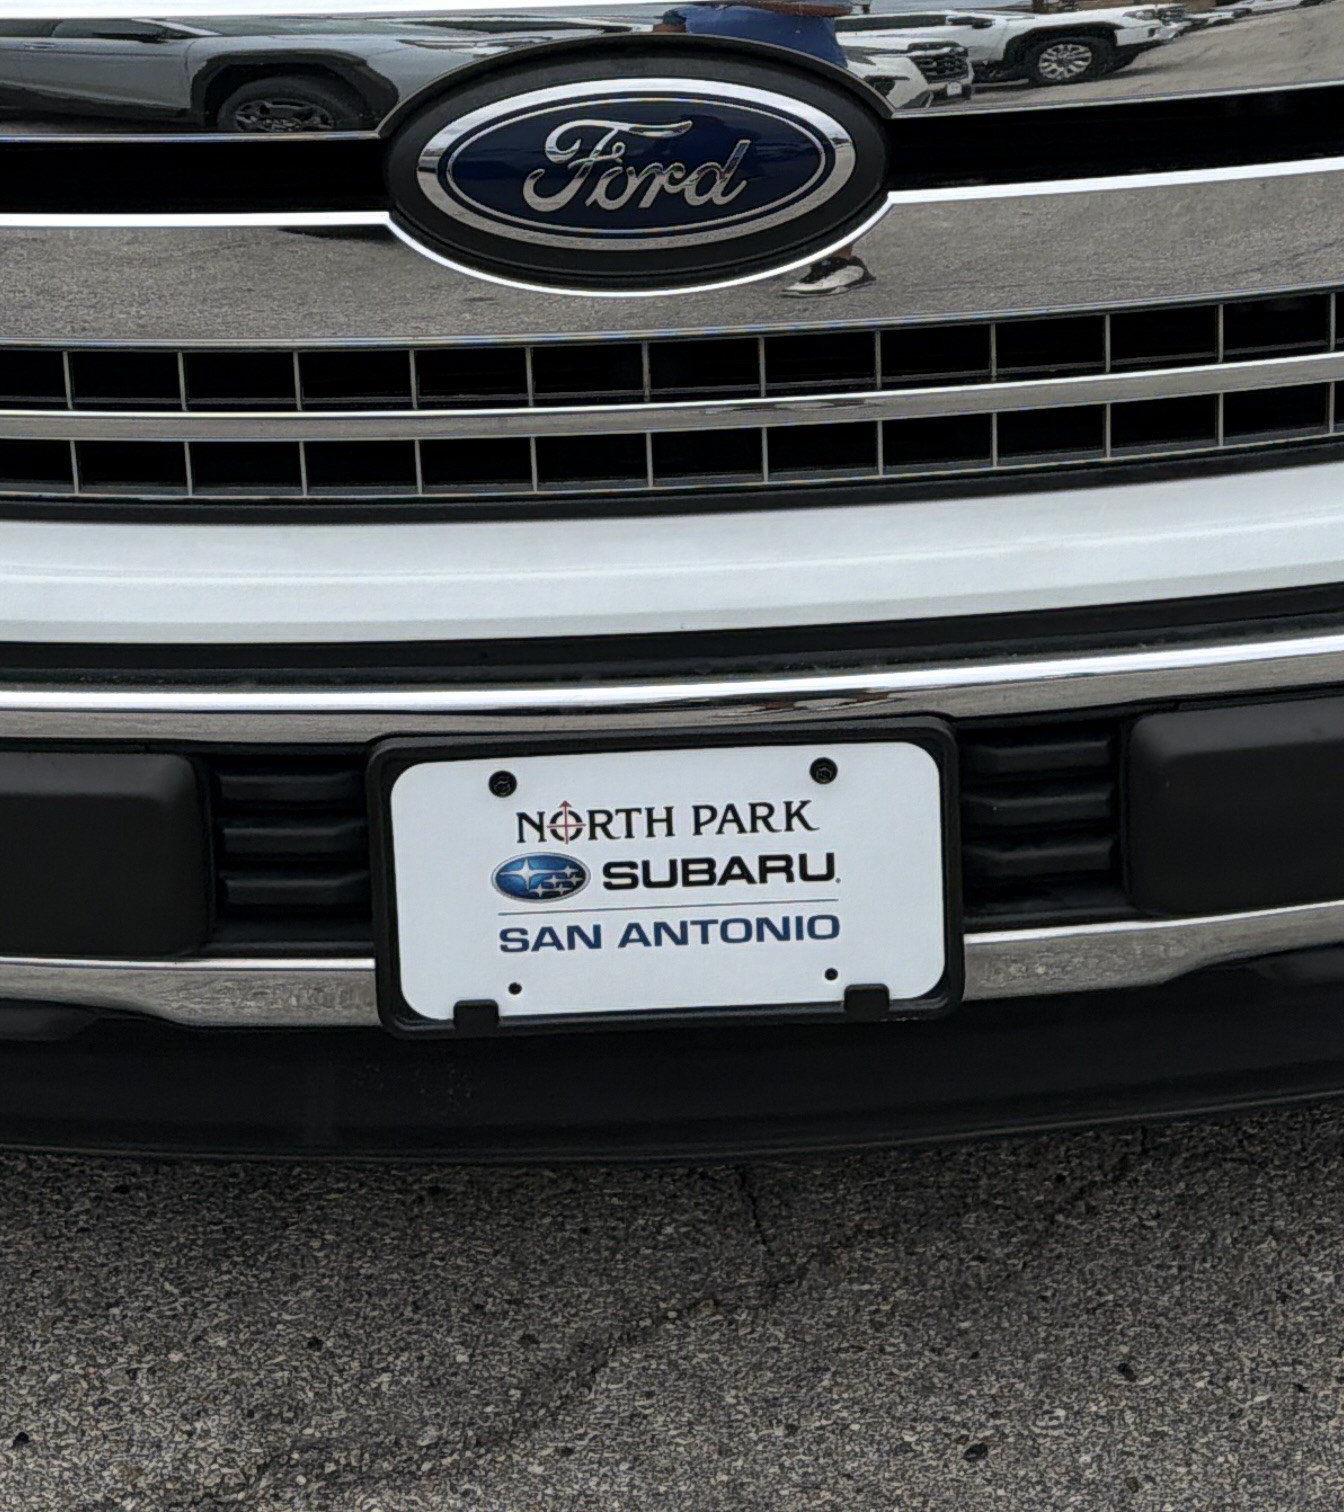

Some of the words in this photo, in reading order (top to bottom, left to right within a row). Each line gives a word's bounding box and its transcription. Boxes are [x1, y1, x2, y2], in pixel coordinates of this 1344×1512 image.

[522, 118, 751, 213] Ford
[516, 801, 675, 844] NORTH
[692, 799, 820, 836] PARK
[602, 852, 836, 890] SUBARU
[499, 923, 602, 953] SAN
[617, 914, 841, 949] ANTONIO
